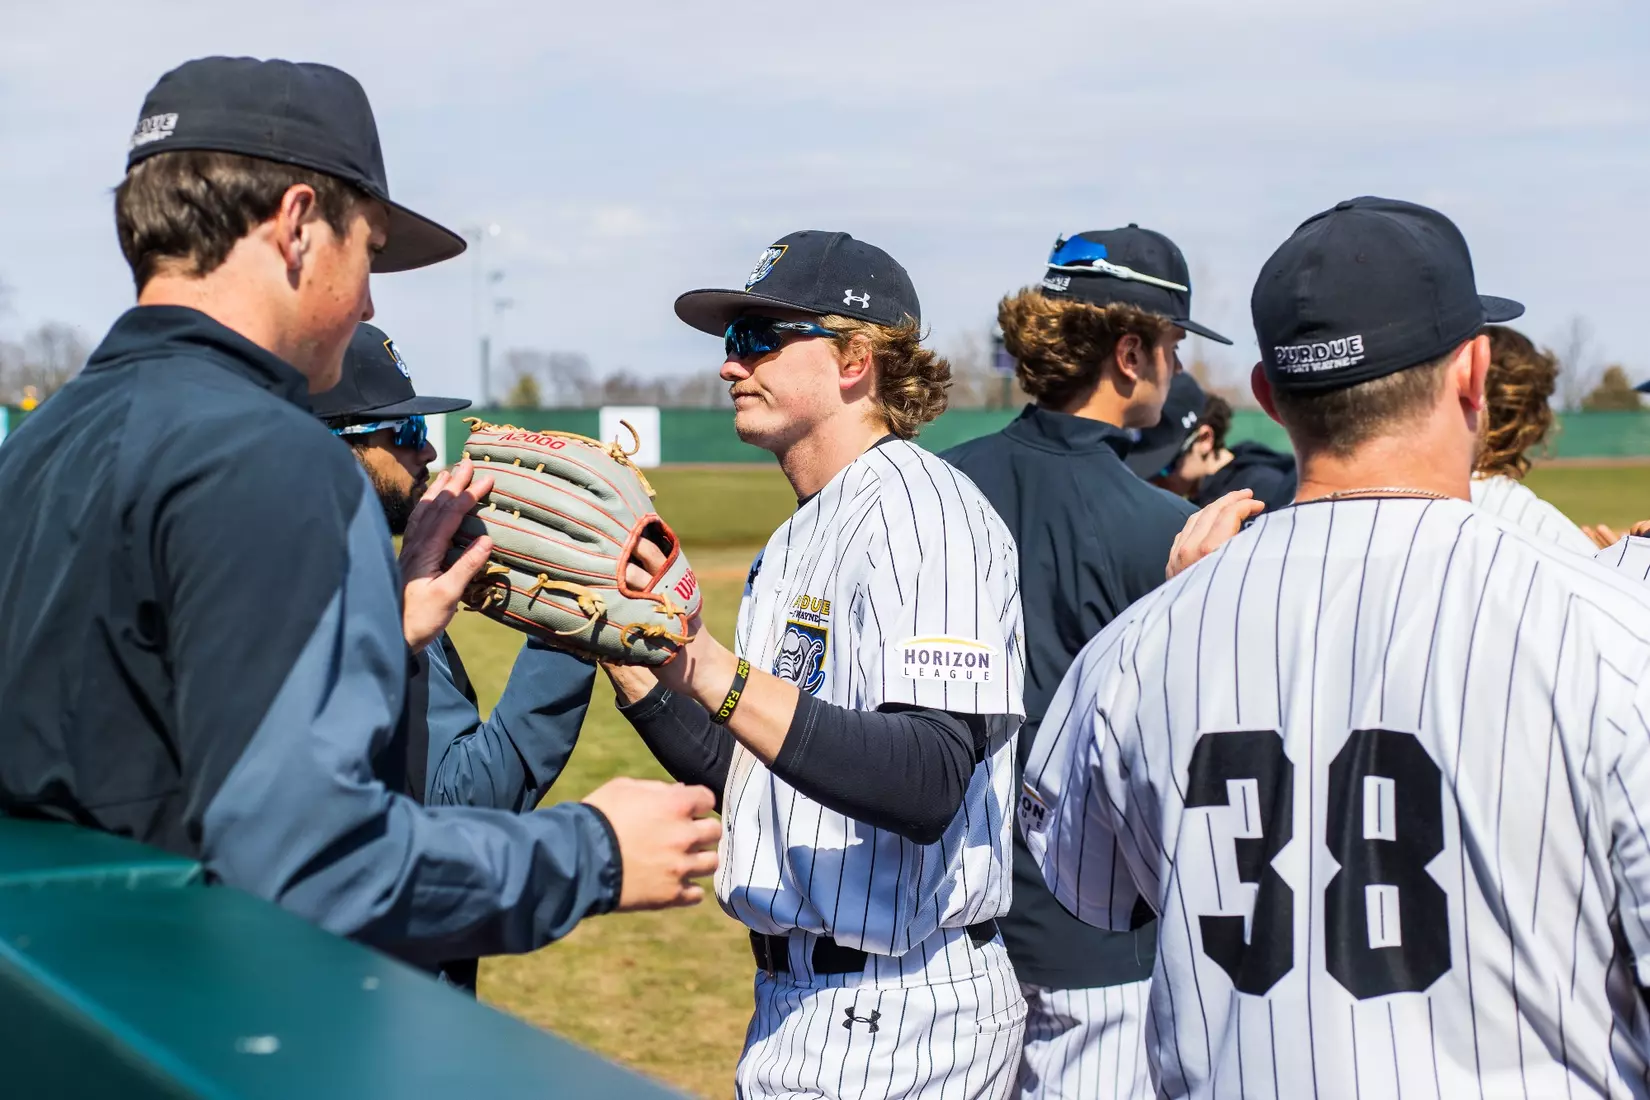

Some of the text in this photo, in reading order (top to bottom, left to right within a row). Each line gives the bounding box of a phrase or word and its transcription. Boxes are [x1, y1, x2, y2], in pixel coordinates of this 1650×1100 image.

[1274, 334, 1364, 364] PURDUE
[498, 431, 567, 450] A2000
[904, 648, 990, 669] HORIZON
[904, 667, 990, 681] LEAGUE
[1184, 728, 1453, 1001] 38
